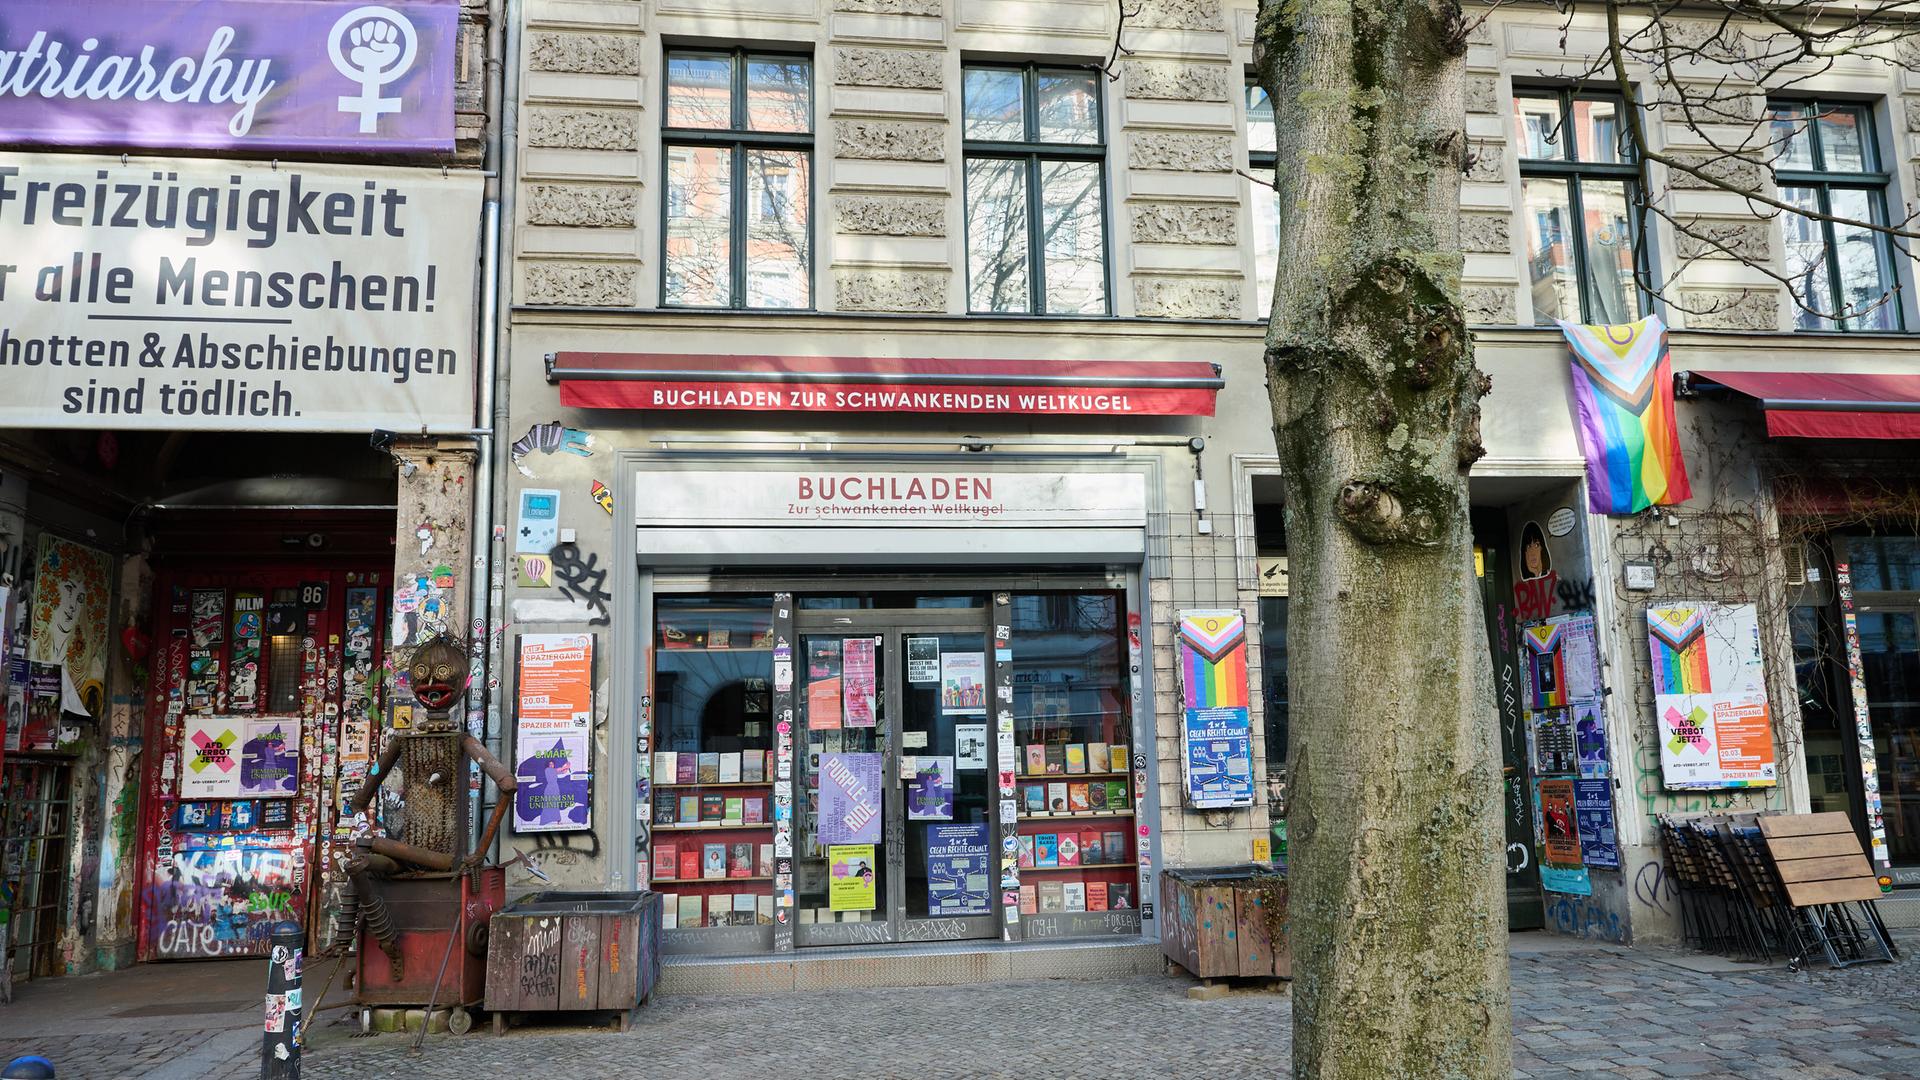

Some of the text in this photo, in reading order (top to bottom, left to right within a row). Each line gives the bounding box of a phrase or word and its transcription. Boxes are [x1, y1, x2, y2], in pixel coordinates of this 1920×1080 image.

[0, 166, 407, 249] Freizügigkeit
[35, 252, 134, 304] alle
[156, 256, 437, 313] Menschen!
[0, 329, 457, 384] hotten & Abschiebungen
[63, 378, 301, 417] sind tödlich.
[653, 389, 1131, 411] BUCHLADEN ZUR SCHWANKENDEN WELTKUGEL
[798, 477, 992, 500] BUCHLADEN
[788, 503, 1003, 516] Zur schwankenden Weltkugel
[235, 597, 264, 611] MLM
[302, 586, 322, 603] 86
[525, 652, 582, 662] SPAZIERGANG
[1717, 710, 1762, 718] SPAZIERGANG
[823, 757, 868, 803] PURPLE
[842, 798, 878, 834] RIDE
